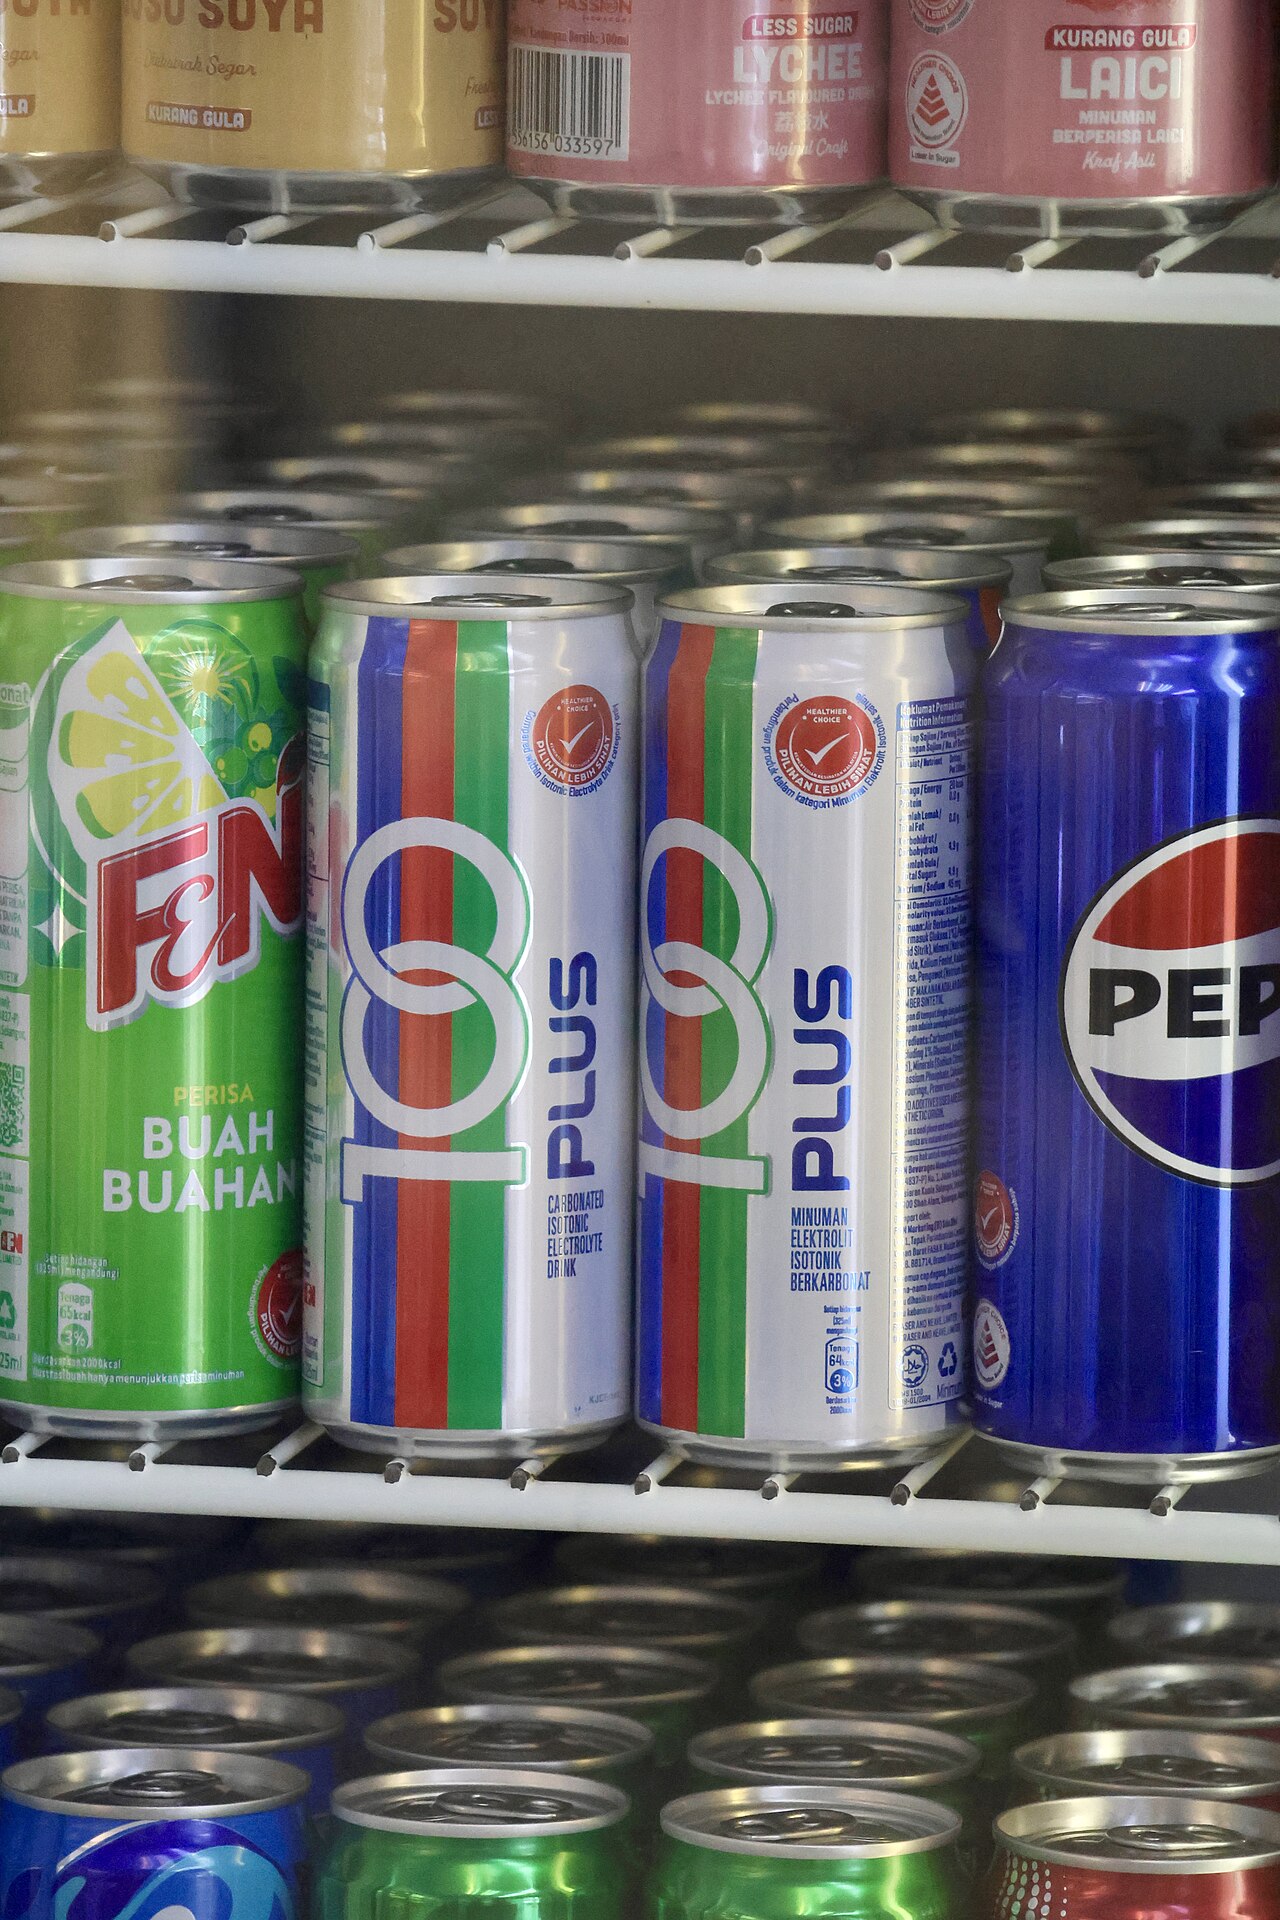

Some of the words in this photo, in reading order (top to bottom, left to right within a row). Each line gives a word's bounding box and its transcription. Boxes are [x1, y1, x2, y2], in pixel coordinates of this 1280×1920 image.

[198, 0, 324, 33] SOYA
[752, 18, 798, 36] LESS
[804, 15, 853, 35] SUGAR
[1053, 28, 1135, 47] KURANG
[1142, 28, 1190, 47] GULA
[206, 54, 257, 81] Segar
[732, 43, 865, 83] LYCHEE
[1060, 56, 1182, 100] LAICI
[705, 89, 764, 105] LYCHEE
[149, 104, 198, 126] KURANG
[202, 109, 245, 129] GULA
[1079, 110, 1156, 125] MINUMAN
[555, 135, 614, 156] 033597
[1052, 128, 1142, 144] BERPERISA
[816, 137, 849, 159] Craft
[1082, 151, 1122, 173] Kraf
[536, 739, 566, 781] PILIHAN
[567, 770, 597, 784] LEBIH
[597, 735, 611, 770] SIHAT
[779, 748, 814, 791] PILIHAN
[814, 779, 851, 795] LEBIH
[850, 748, 873, 783] SIHAT
[773, 775, 797, 799] dalam
[1089, 963, 1280, 1038] PEP
[547, 951, 598, 1180] PLUS
[792, 964, 853, 1192] PLUS
[174, 1083, 255, 1106] PERISA
[143, 1110, 274, 1159] BUAH
[103, 1158, 297, 1213] BUAHAN
[548, 1189, 604, 1214] CARBONATED
[548, 1213, 589, 1236] ISOTONIC
[791, 1206, 848, 1227] MINUMAN
[547, 1232, 603, 1257] ELECTROLYTE
[791, 1228, 855, 1249] ELEKTROLIT
[547, 1257, 577, 1279] DRINK
[791, 1250, 842, 1270] ISOTONIK
[791, 1271, 871, 1292] BERKARBONAT
[833, 1373, 851, 1388] 3%
